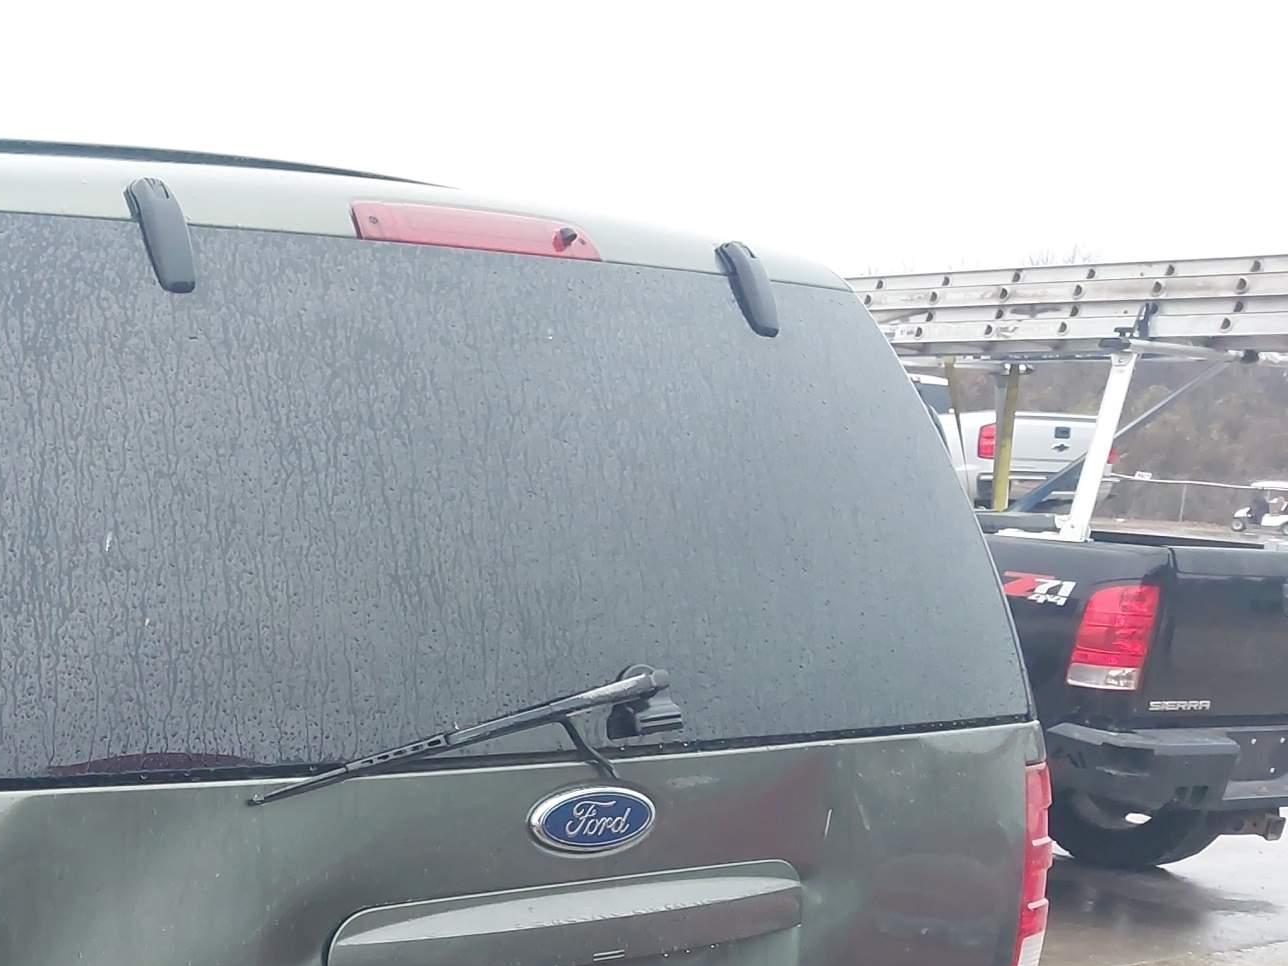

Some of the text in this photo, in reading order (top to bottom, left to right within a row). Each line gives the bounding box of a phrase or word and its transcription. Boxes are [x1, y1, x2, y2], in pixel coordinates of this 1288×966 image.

[1002, 570, 1077, 598] Z71
[1148, 700, 1211, 711] SIERRA
[565, 800, 632, 837] Ford
